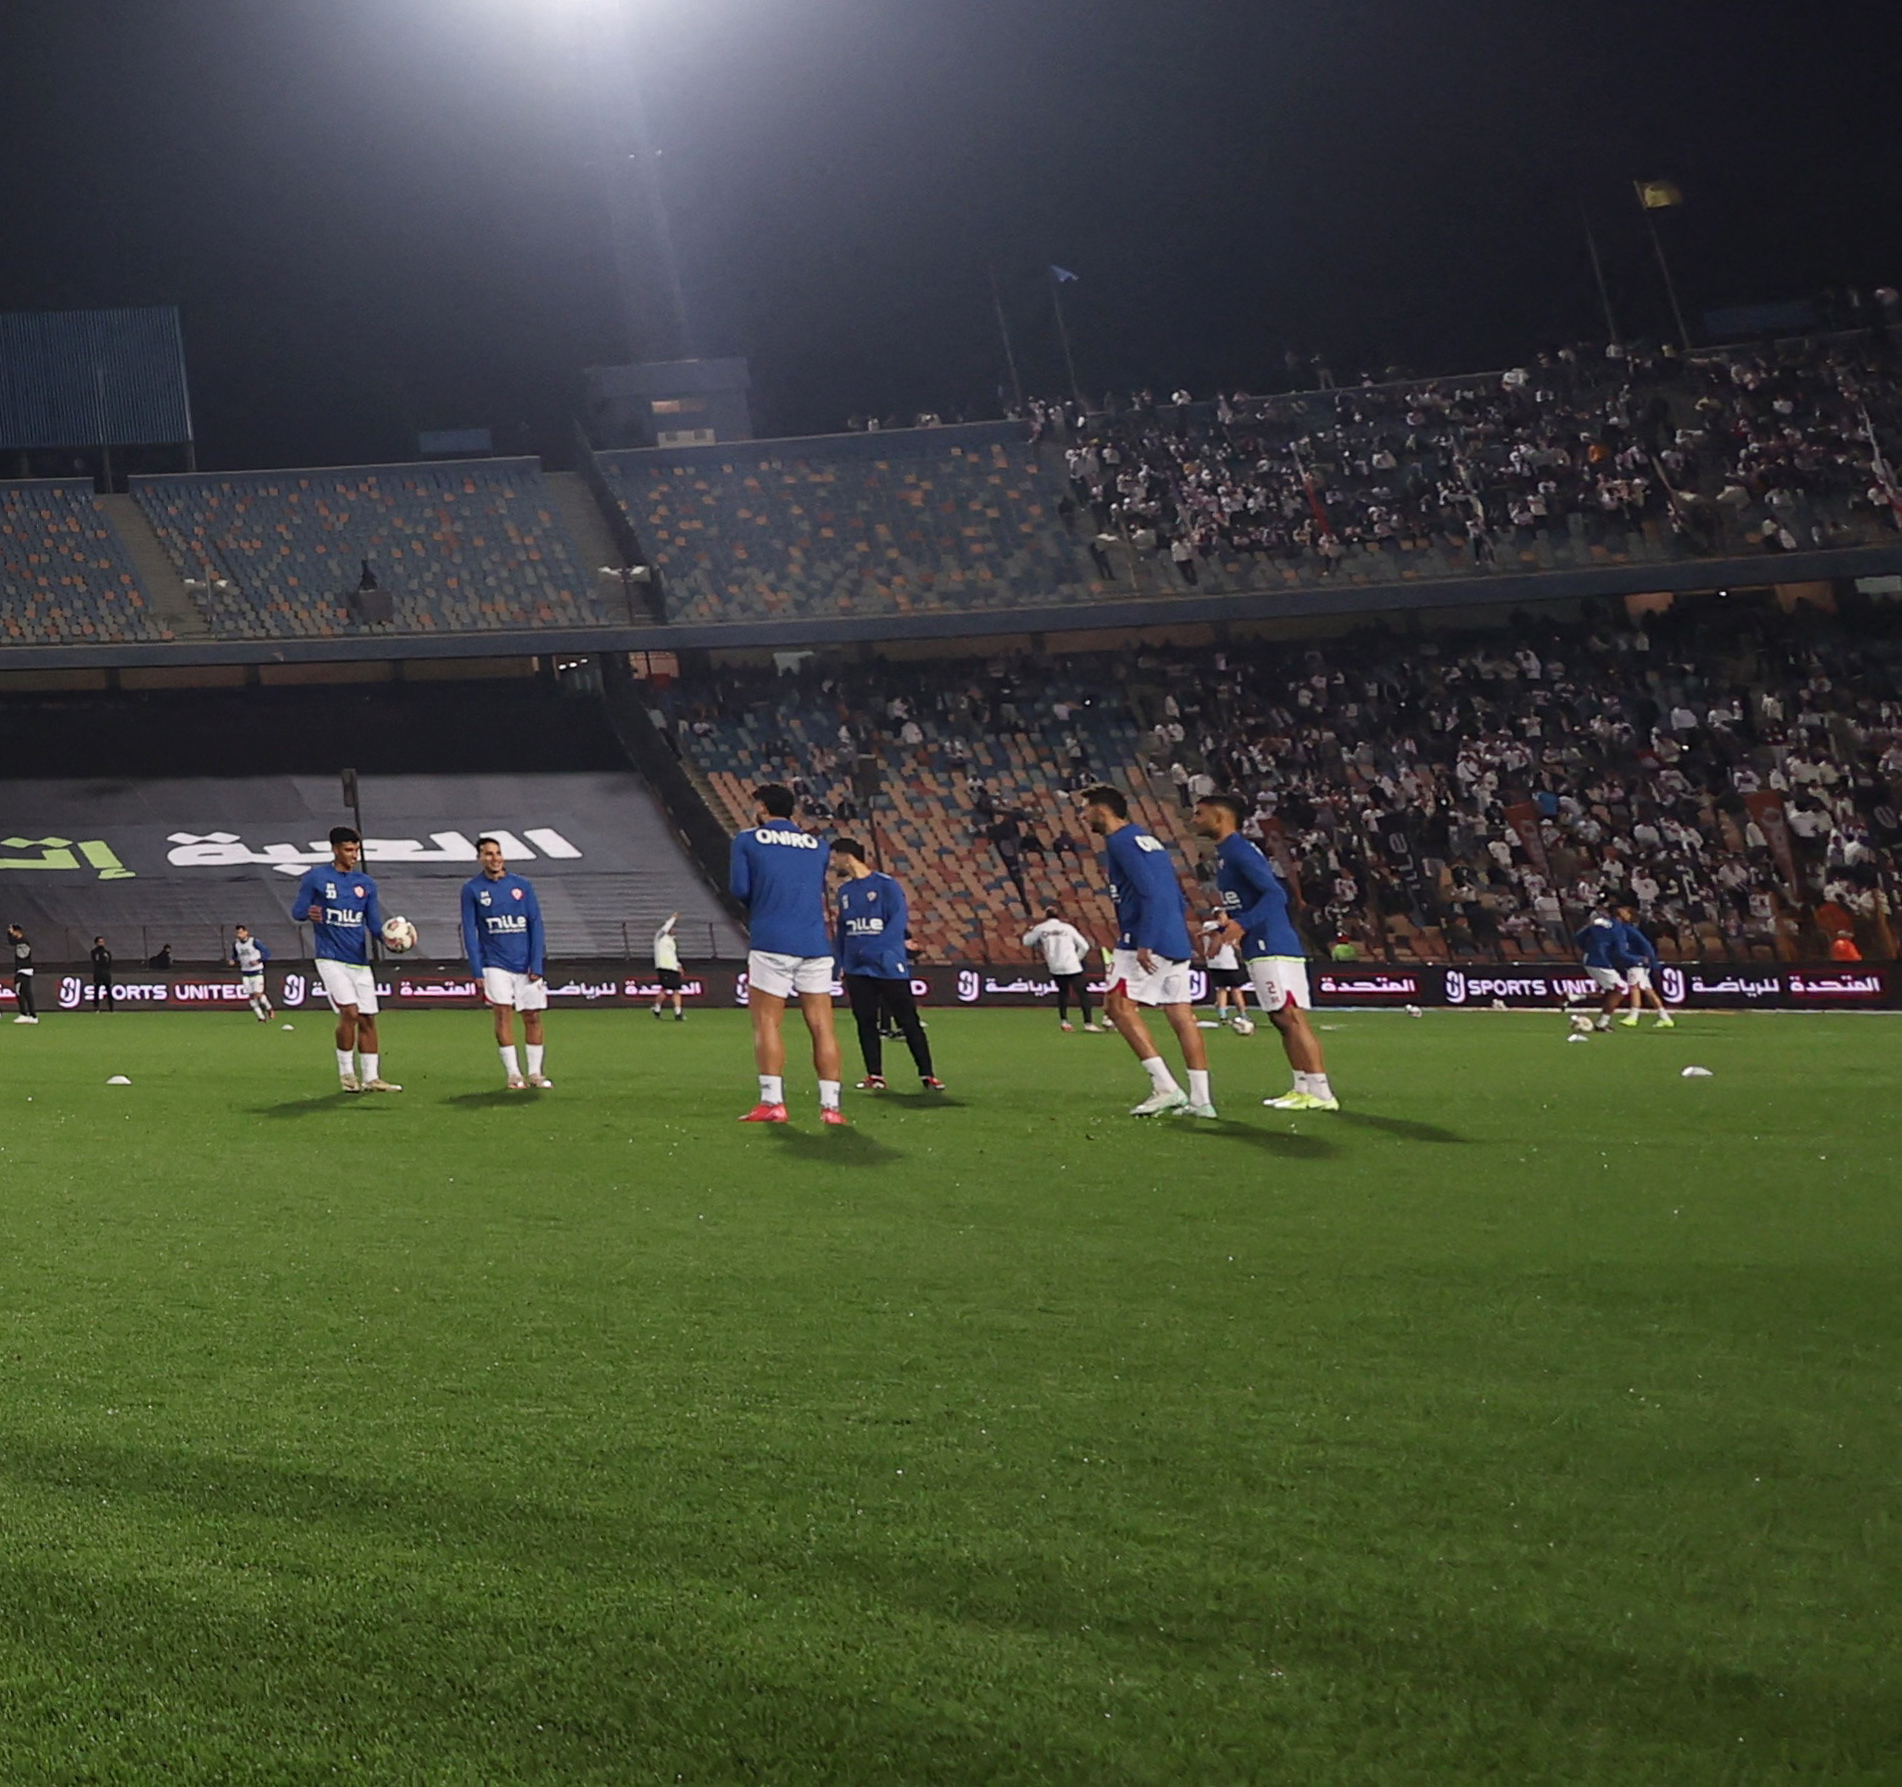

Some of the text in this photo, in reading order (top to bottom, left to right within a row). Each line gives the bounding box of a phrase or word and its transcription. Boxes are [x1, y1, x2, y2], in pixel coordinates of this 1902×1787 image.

[755, 828, 819, 849] ONIRO
[400, 982, 476, 996] المتحدة
[1320, 978, 1415, 993] المتحدة
[1467, 980, 1546, 995] SPORTS
[1691, 975, 1881, 997] المتحدة للرياضة
